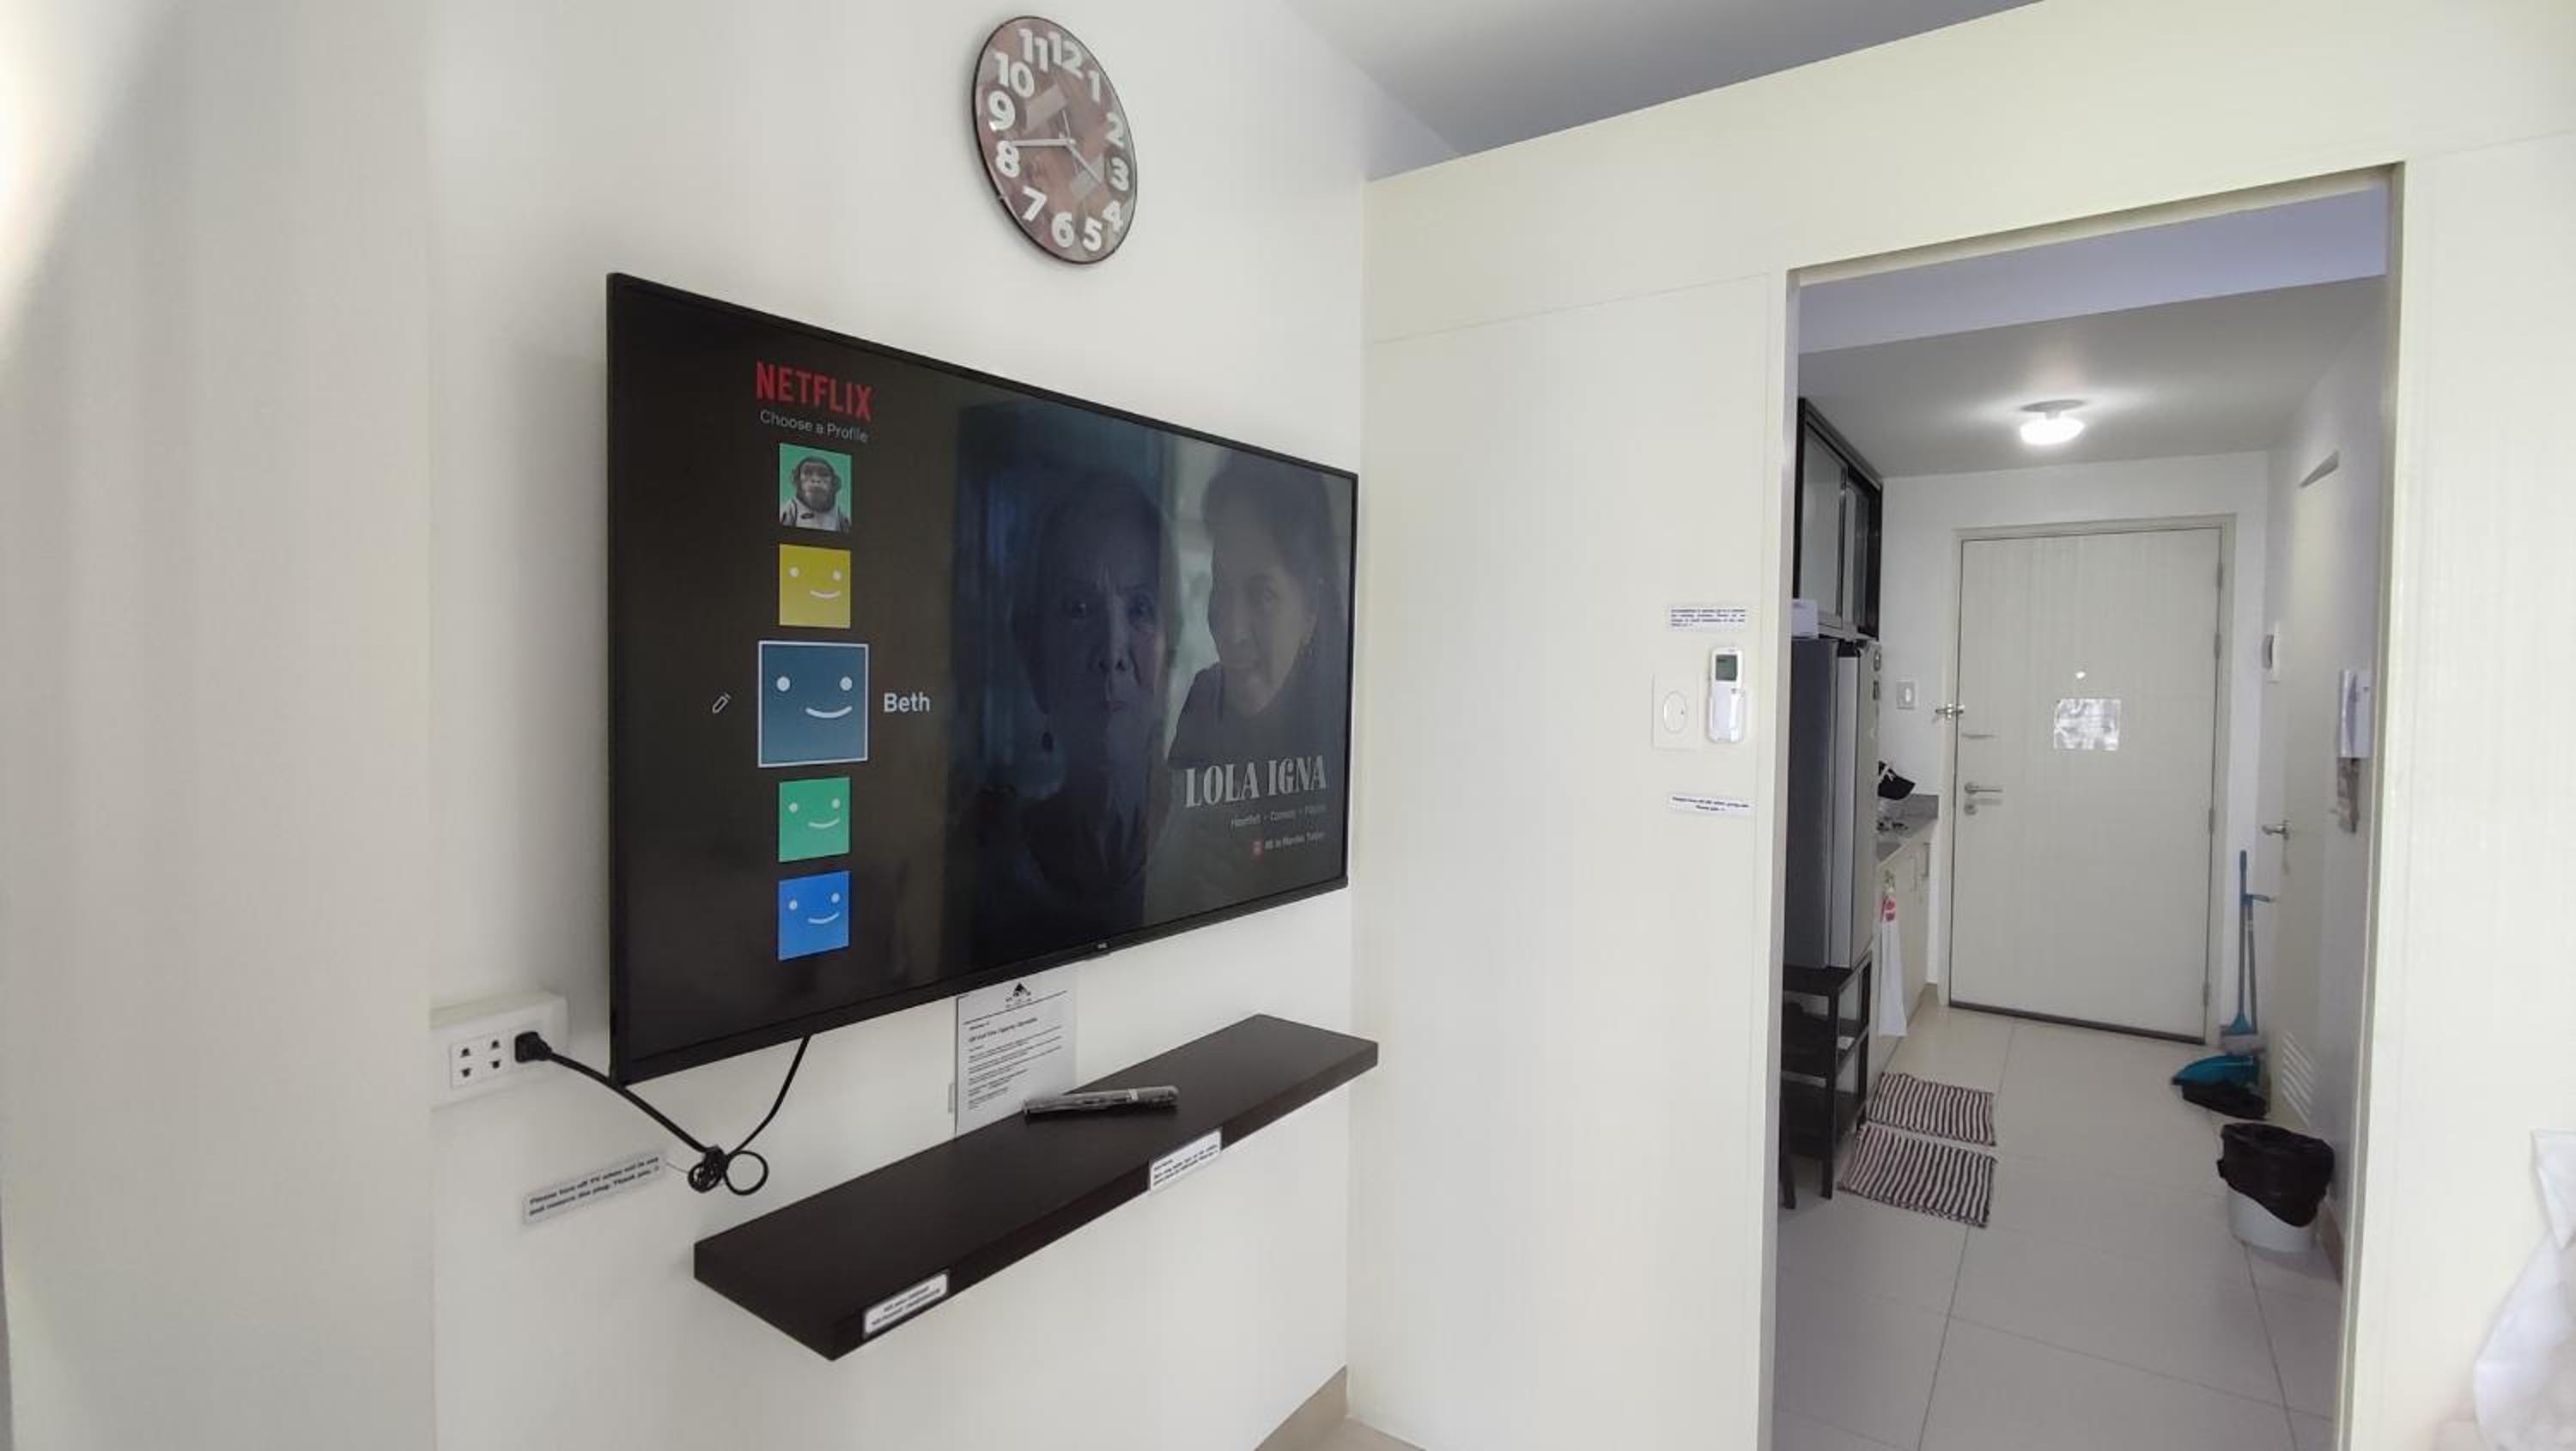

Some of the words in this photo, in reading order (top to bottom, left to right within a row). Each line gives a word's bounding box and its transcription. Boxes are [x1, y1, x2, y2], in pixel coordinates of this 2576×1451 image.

[1018, 28, 1048, 73] 11
[1048, 31, 1084, 79] 12
[993, 52, 1035, 98] 10
[1088, 70, 1101, 104] 1
[987, 89, 1016, 131] 9
[1107, 112, 1124, 148] 2
[995, 140, 1020, 178] 8
[1110, 157, 1129, 192] 3
[1023, 185, 1047, 222] 7
[1103, 200, 1123, 233] 4
[1051, 212, 1073, 247] 6
[1082, 217, 1103, 252] 5
[756, 361, 872, 422] NETFLIX
[760, 410, 812, 432] Choose
[816, 423, 824, 434] a
[827, 422, 868, 443] Profile
[884, 691, 930, 713] Beth
[1186, 762, 1261, 808] LOLA
[1268, 755, 1327, 796] IGNA
